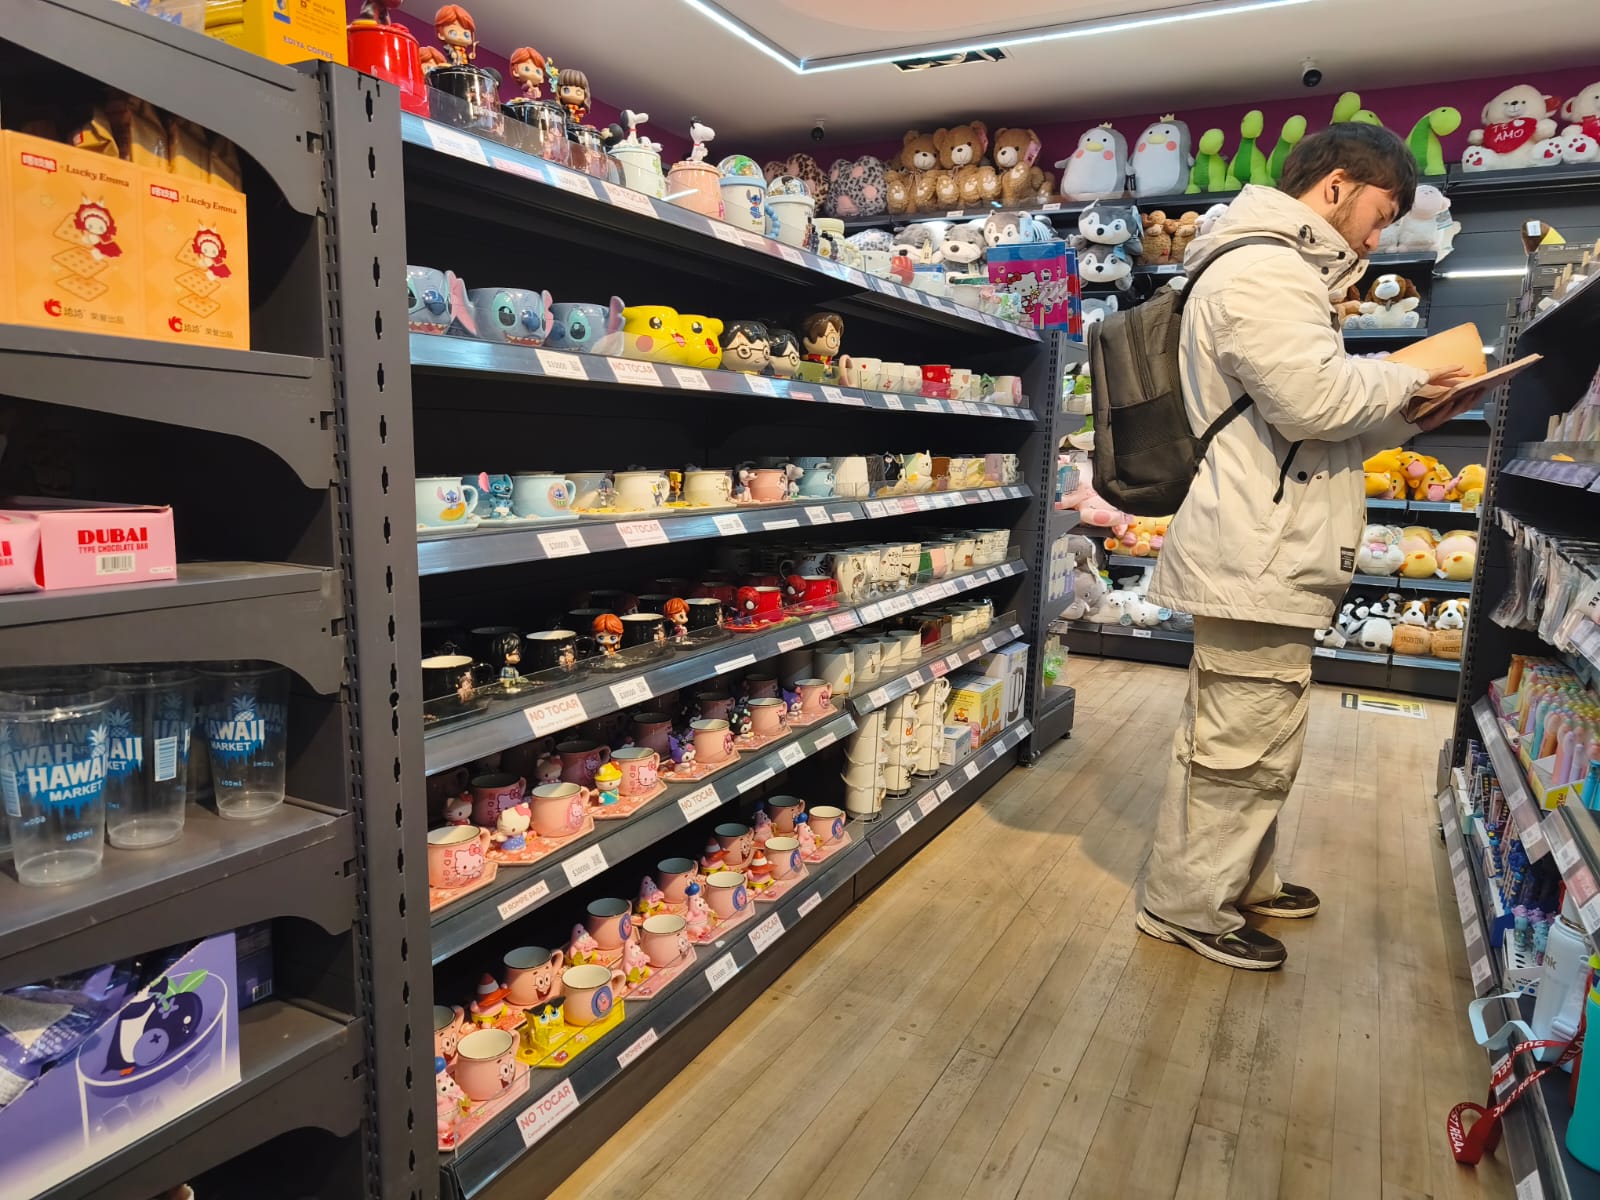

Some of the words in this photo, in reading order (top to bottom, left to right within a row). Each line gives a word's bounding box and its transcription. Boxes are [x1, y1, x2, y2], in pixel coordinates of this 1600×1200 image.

[306, 45, 334, 60] COFFEE
[1494, 128, 1525, 143] AMO
[65, 164, 97, 181] Lucky
[99, 172, 129, 187] Emma
[186, 194, 212, 209] Lucky
[213, 201, 237, 214] Emma
[612, 361, 625, 371] NO
[77, 527, 148, 545] DUBAI
[620, 525, 632, 535] NO
[634, 523, 659, 533] TOCAR
[78, 546, 96, 554] TYPE
[98, 543, 134, 553] CHOCOLATE
[529, 709, 545, 722] NO
[545, 698, 579, 715] TOCAR
[209, 720, 265, 742] AWAII
[49, 779, 103, 802] MARKET
[681, 799, 692, 810] NO
[692, 787, 715, 805] TOCAR
[751, 932, 760, 943] NO
[760, 916, 778, 935] TOCAR
[520, 1111, 537, 1131] NO
[537, 1084, 571, 1115] TOCAR
[1493, 1091, 1516, 1118] JUST
